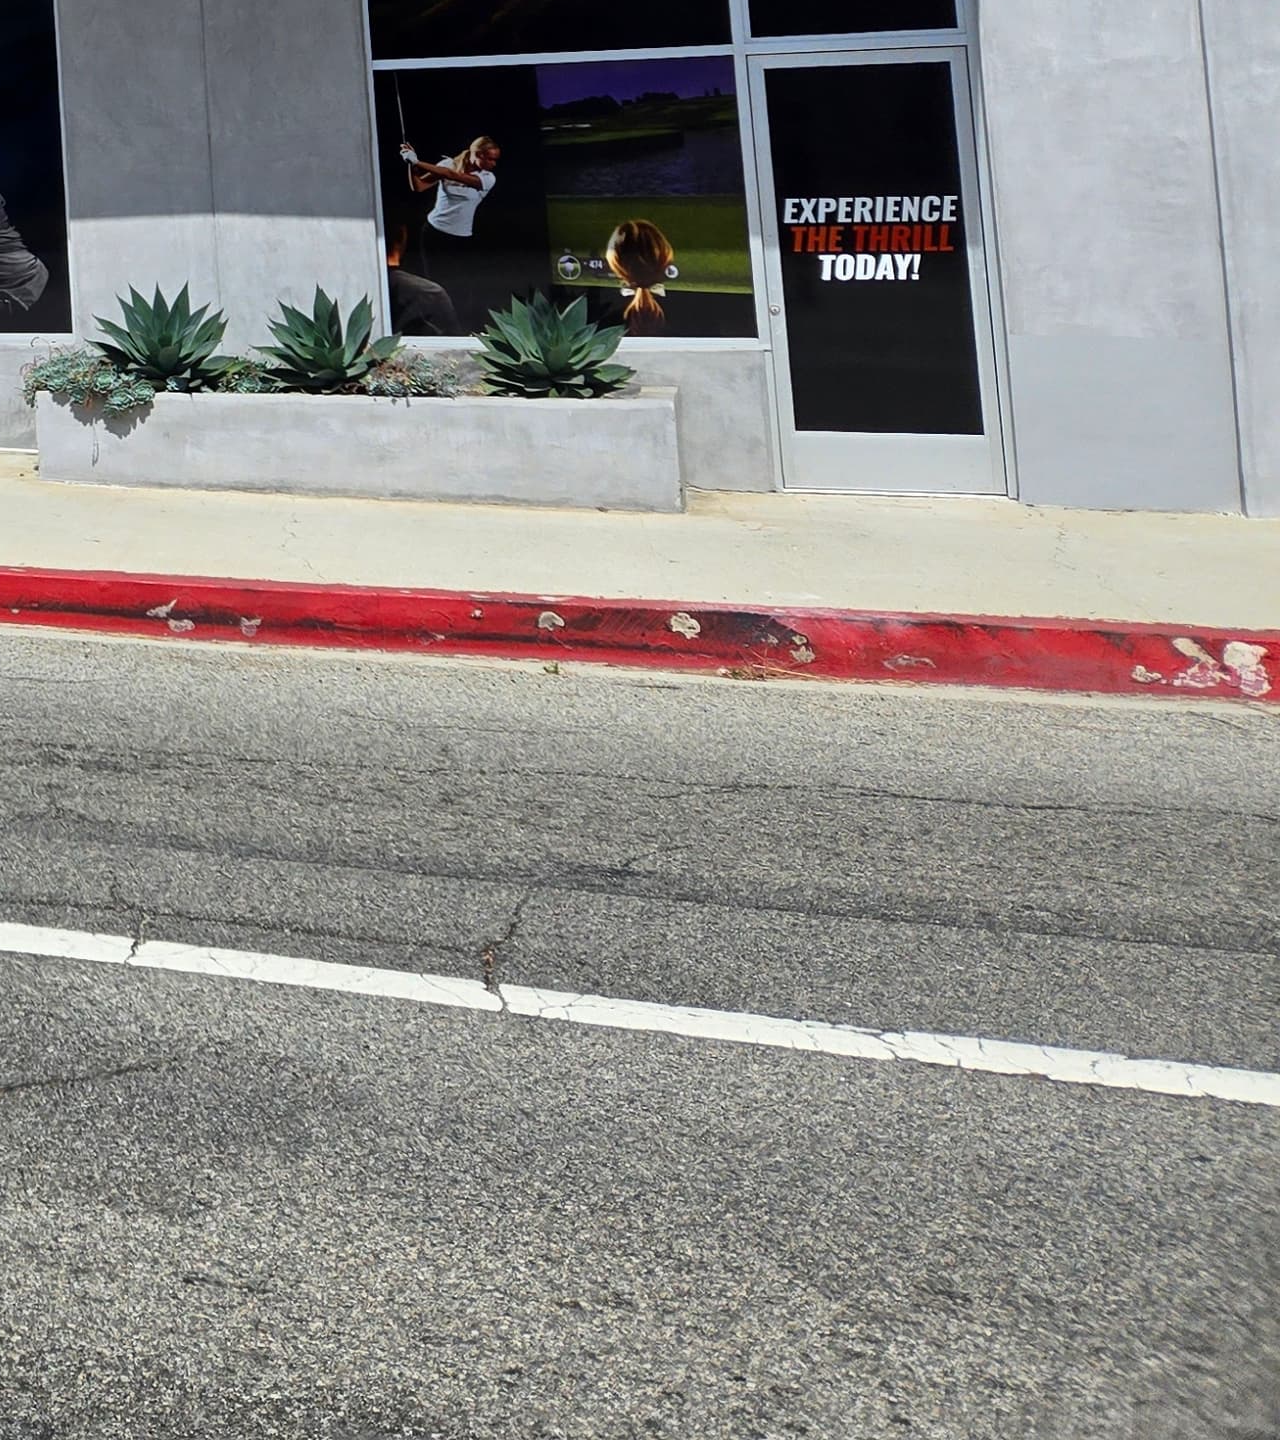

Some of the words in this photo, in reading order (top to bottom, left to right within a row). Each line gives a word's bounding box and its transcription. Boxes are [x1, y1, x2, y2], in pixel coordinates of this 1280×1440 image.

[783, 195, 958, 224] EXPERIENCE
[791, 226, 843, 253] THE
[853, 224, 955, 253] THRILL
[818, 253, 922, 282] TODAY!
